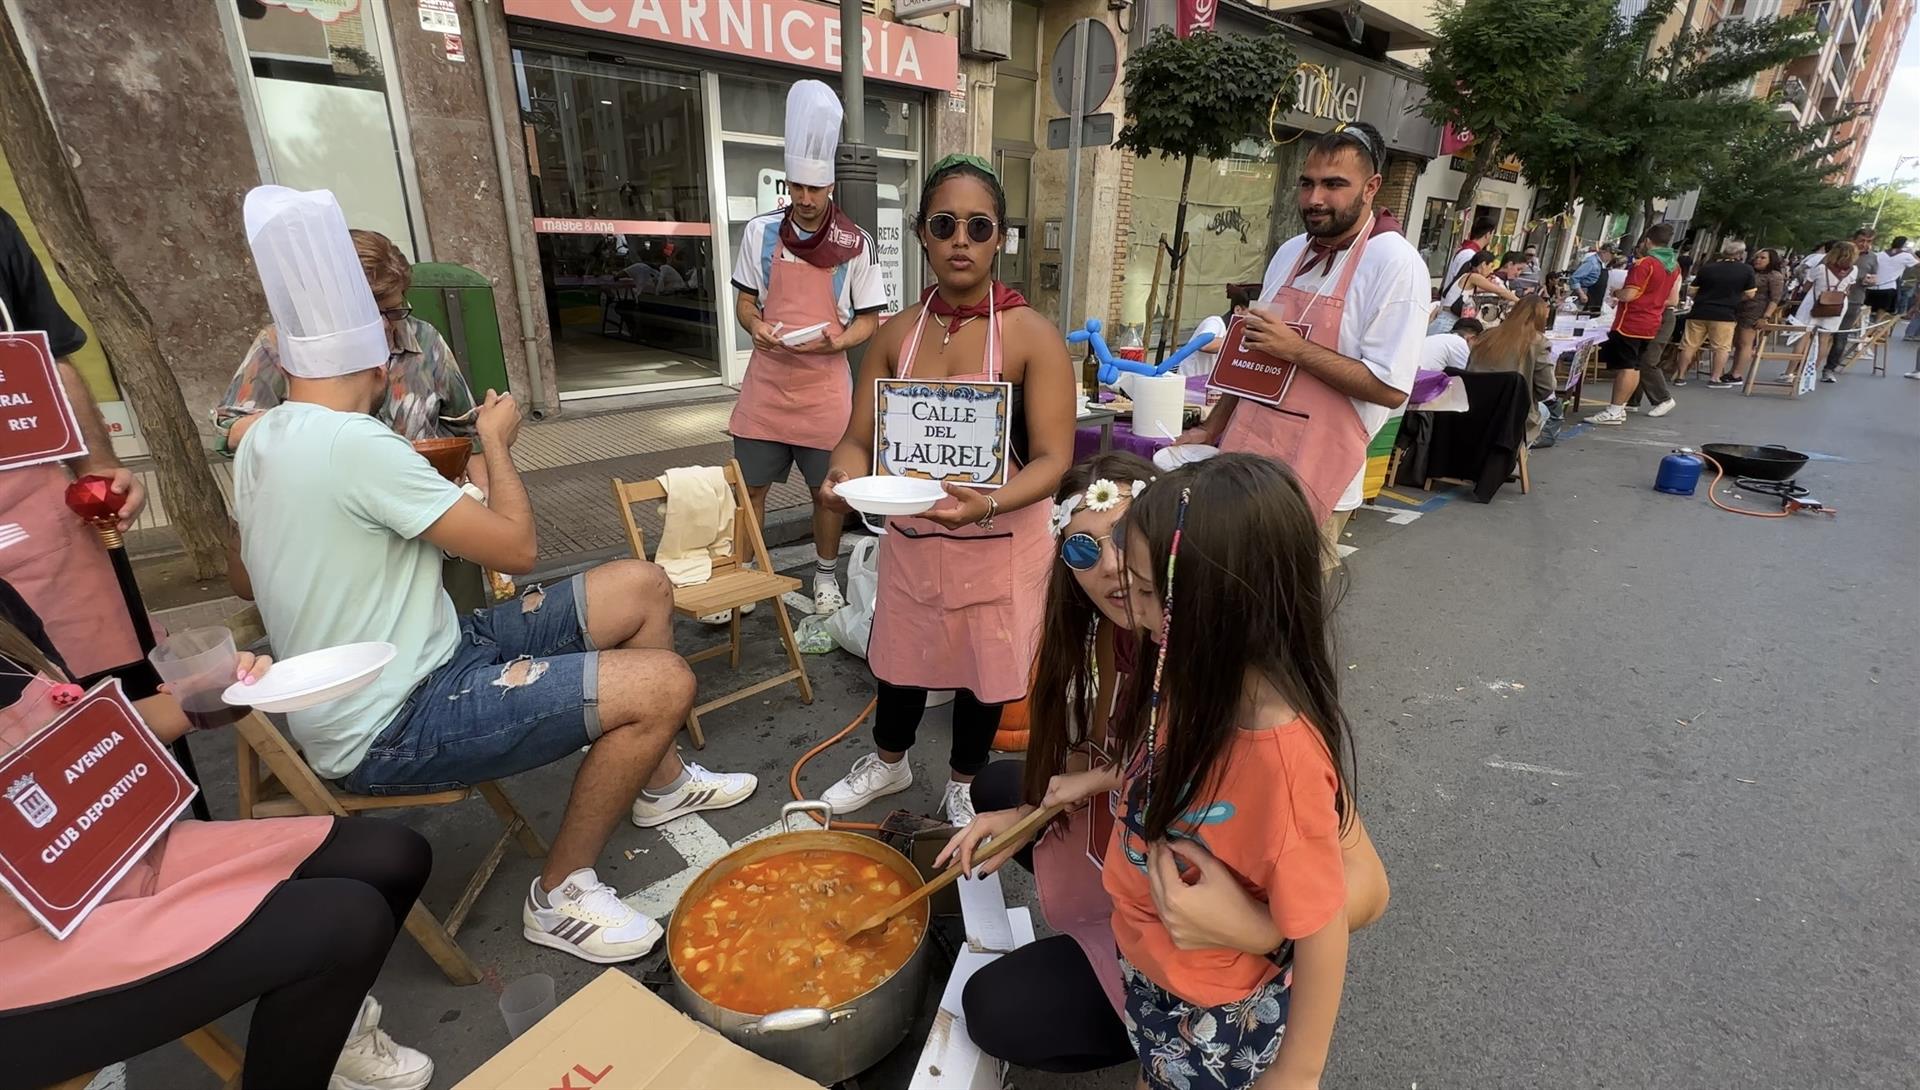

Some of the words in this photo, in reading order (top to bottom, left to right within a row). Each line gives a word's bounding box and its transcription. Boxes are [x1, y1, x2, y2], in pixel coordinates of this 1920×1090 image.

[584, 222, 593, 231] &
[1231, 359, 1255, 371] MADRE
[1254, 364, 1265, 373] DE
[1264, 365, 1282, 376] DIOS
[0, 393, 33, 408] RAL
[912, 401, 977, 423] CALLE
[8, 416, 38, 431] REY
[924, 425, 957, 438] DEL
[892, 442, 991, 468] LAUREL
[64, 731, 125, 784] AVENIDA
[41, 826, 81, 864] CLUB
[76, 763, 148, 830] DEPORTIVO
